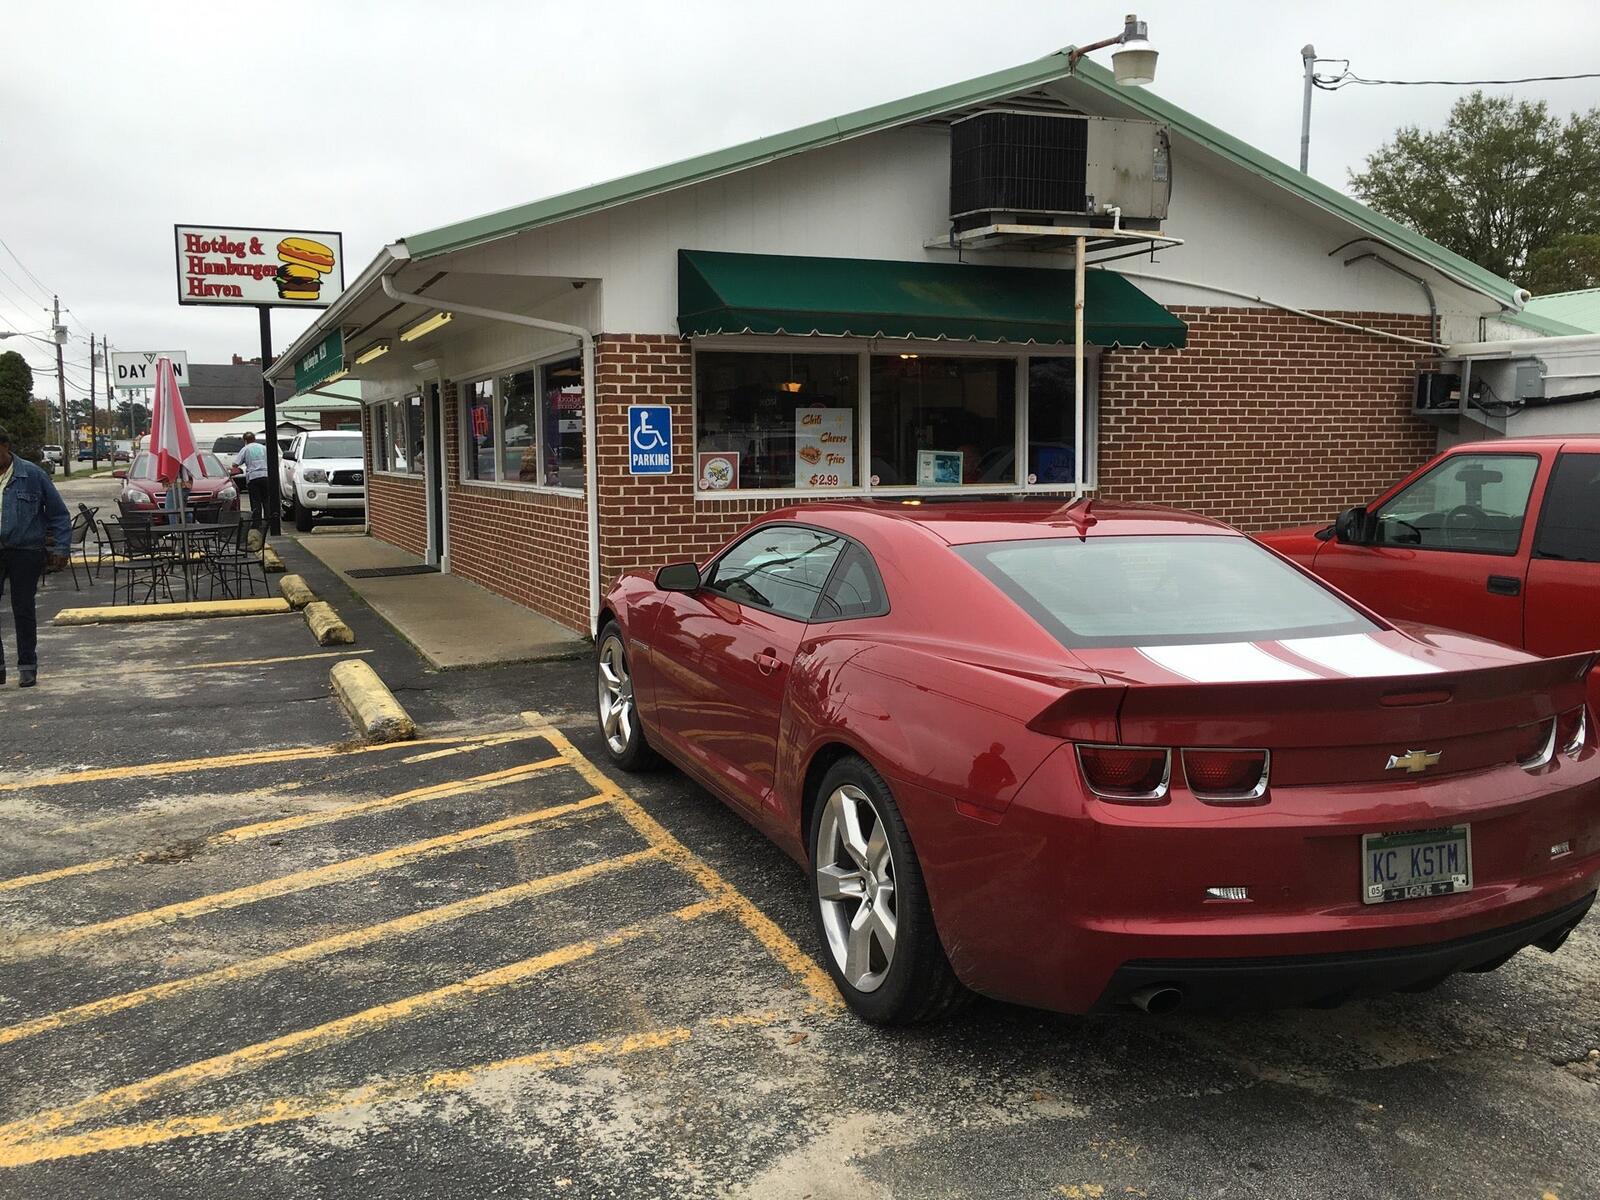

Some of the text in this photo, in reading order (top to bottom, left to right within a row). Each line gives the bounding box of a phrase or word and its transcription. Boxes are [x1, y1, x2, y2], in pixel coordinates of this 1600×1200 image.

[183, 233, 265, 258] Hotdog &
[186, 255, 278, 281] Hamburger
[186, 277, 243, 297] Haven
[118, 364, 146, 378] DAY
[802, 414, 822, 425] Chili
[820, 432, 847, 443] Cheese
[633, 453, 669, 466] PARKING
[826, 453, 845, 466] Fries
[809, 473, 838, 487] $2.99
[1373, 843, 1458, 883] KC KSTM
[1371, 886, 1380, 895] 05
